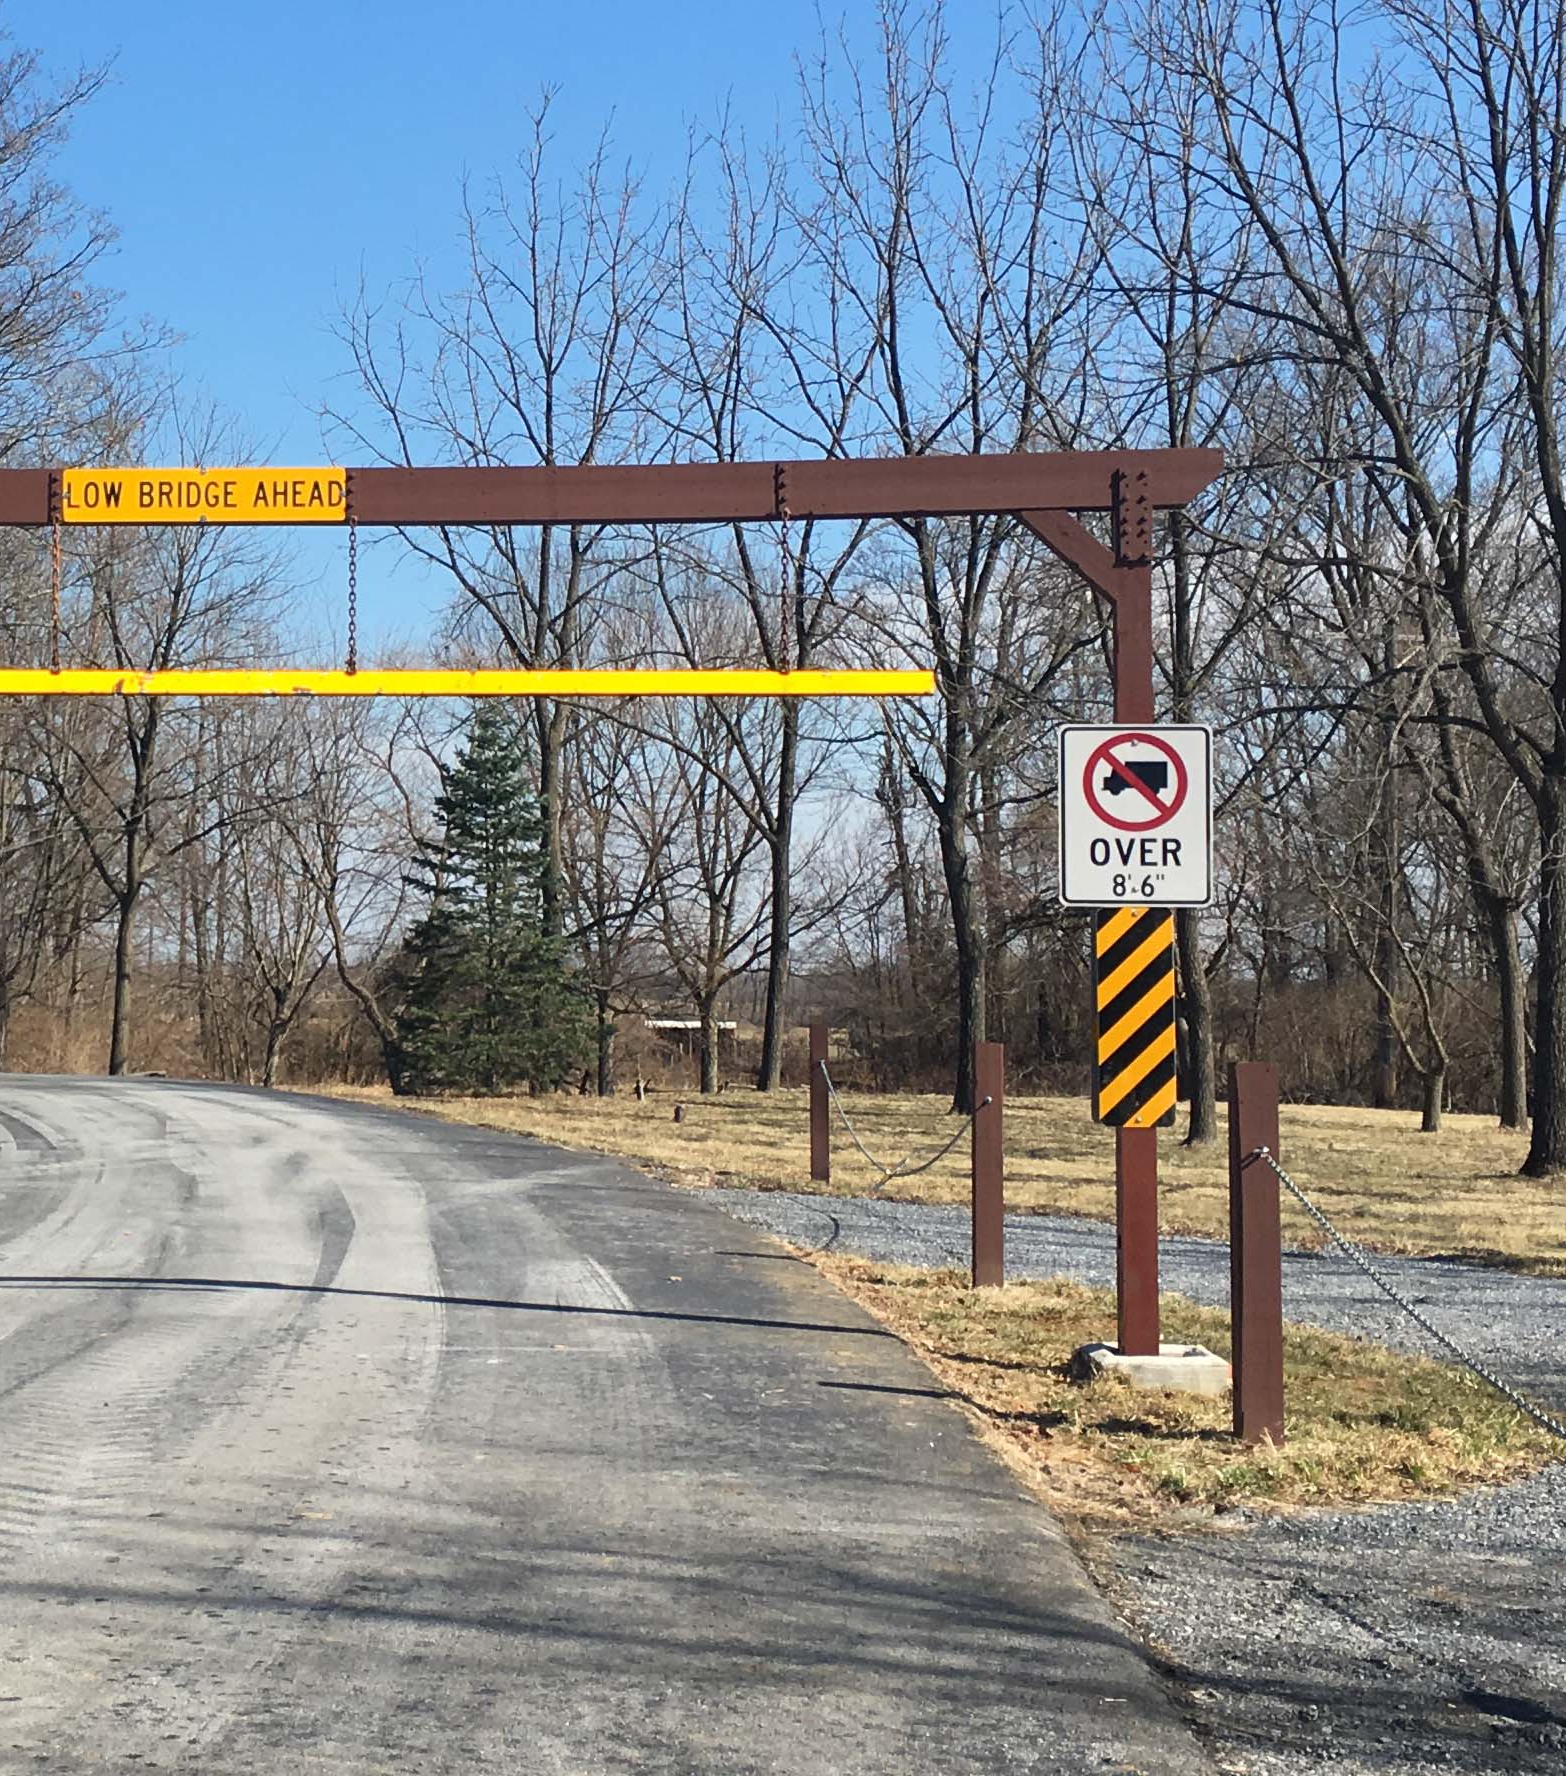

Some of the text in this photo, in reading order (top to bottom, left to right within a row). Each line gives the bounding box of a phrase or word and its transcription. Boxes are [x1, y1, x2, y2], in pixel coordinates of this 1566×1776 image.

[66, 480, 343, 508] LOW BRIDGE AHEAD
[1090, 838, 1182, 867] OVER
